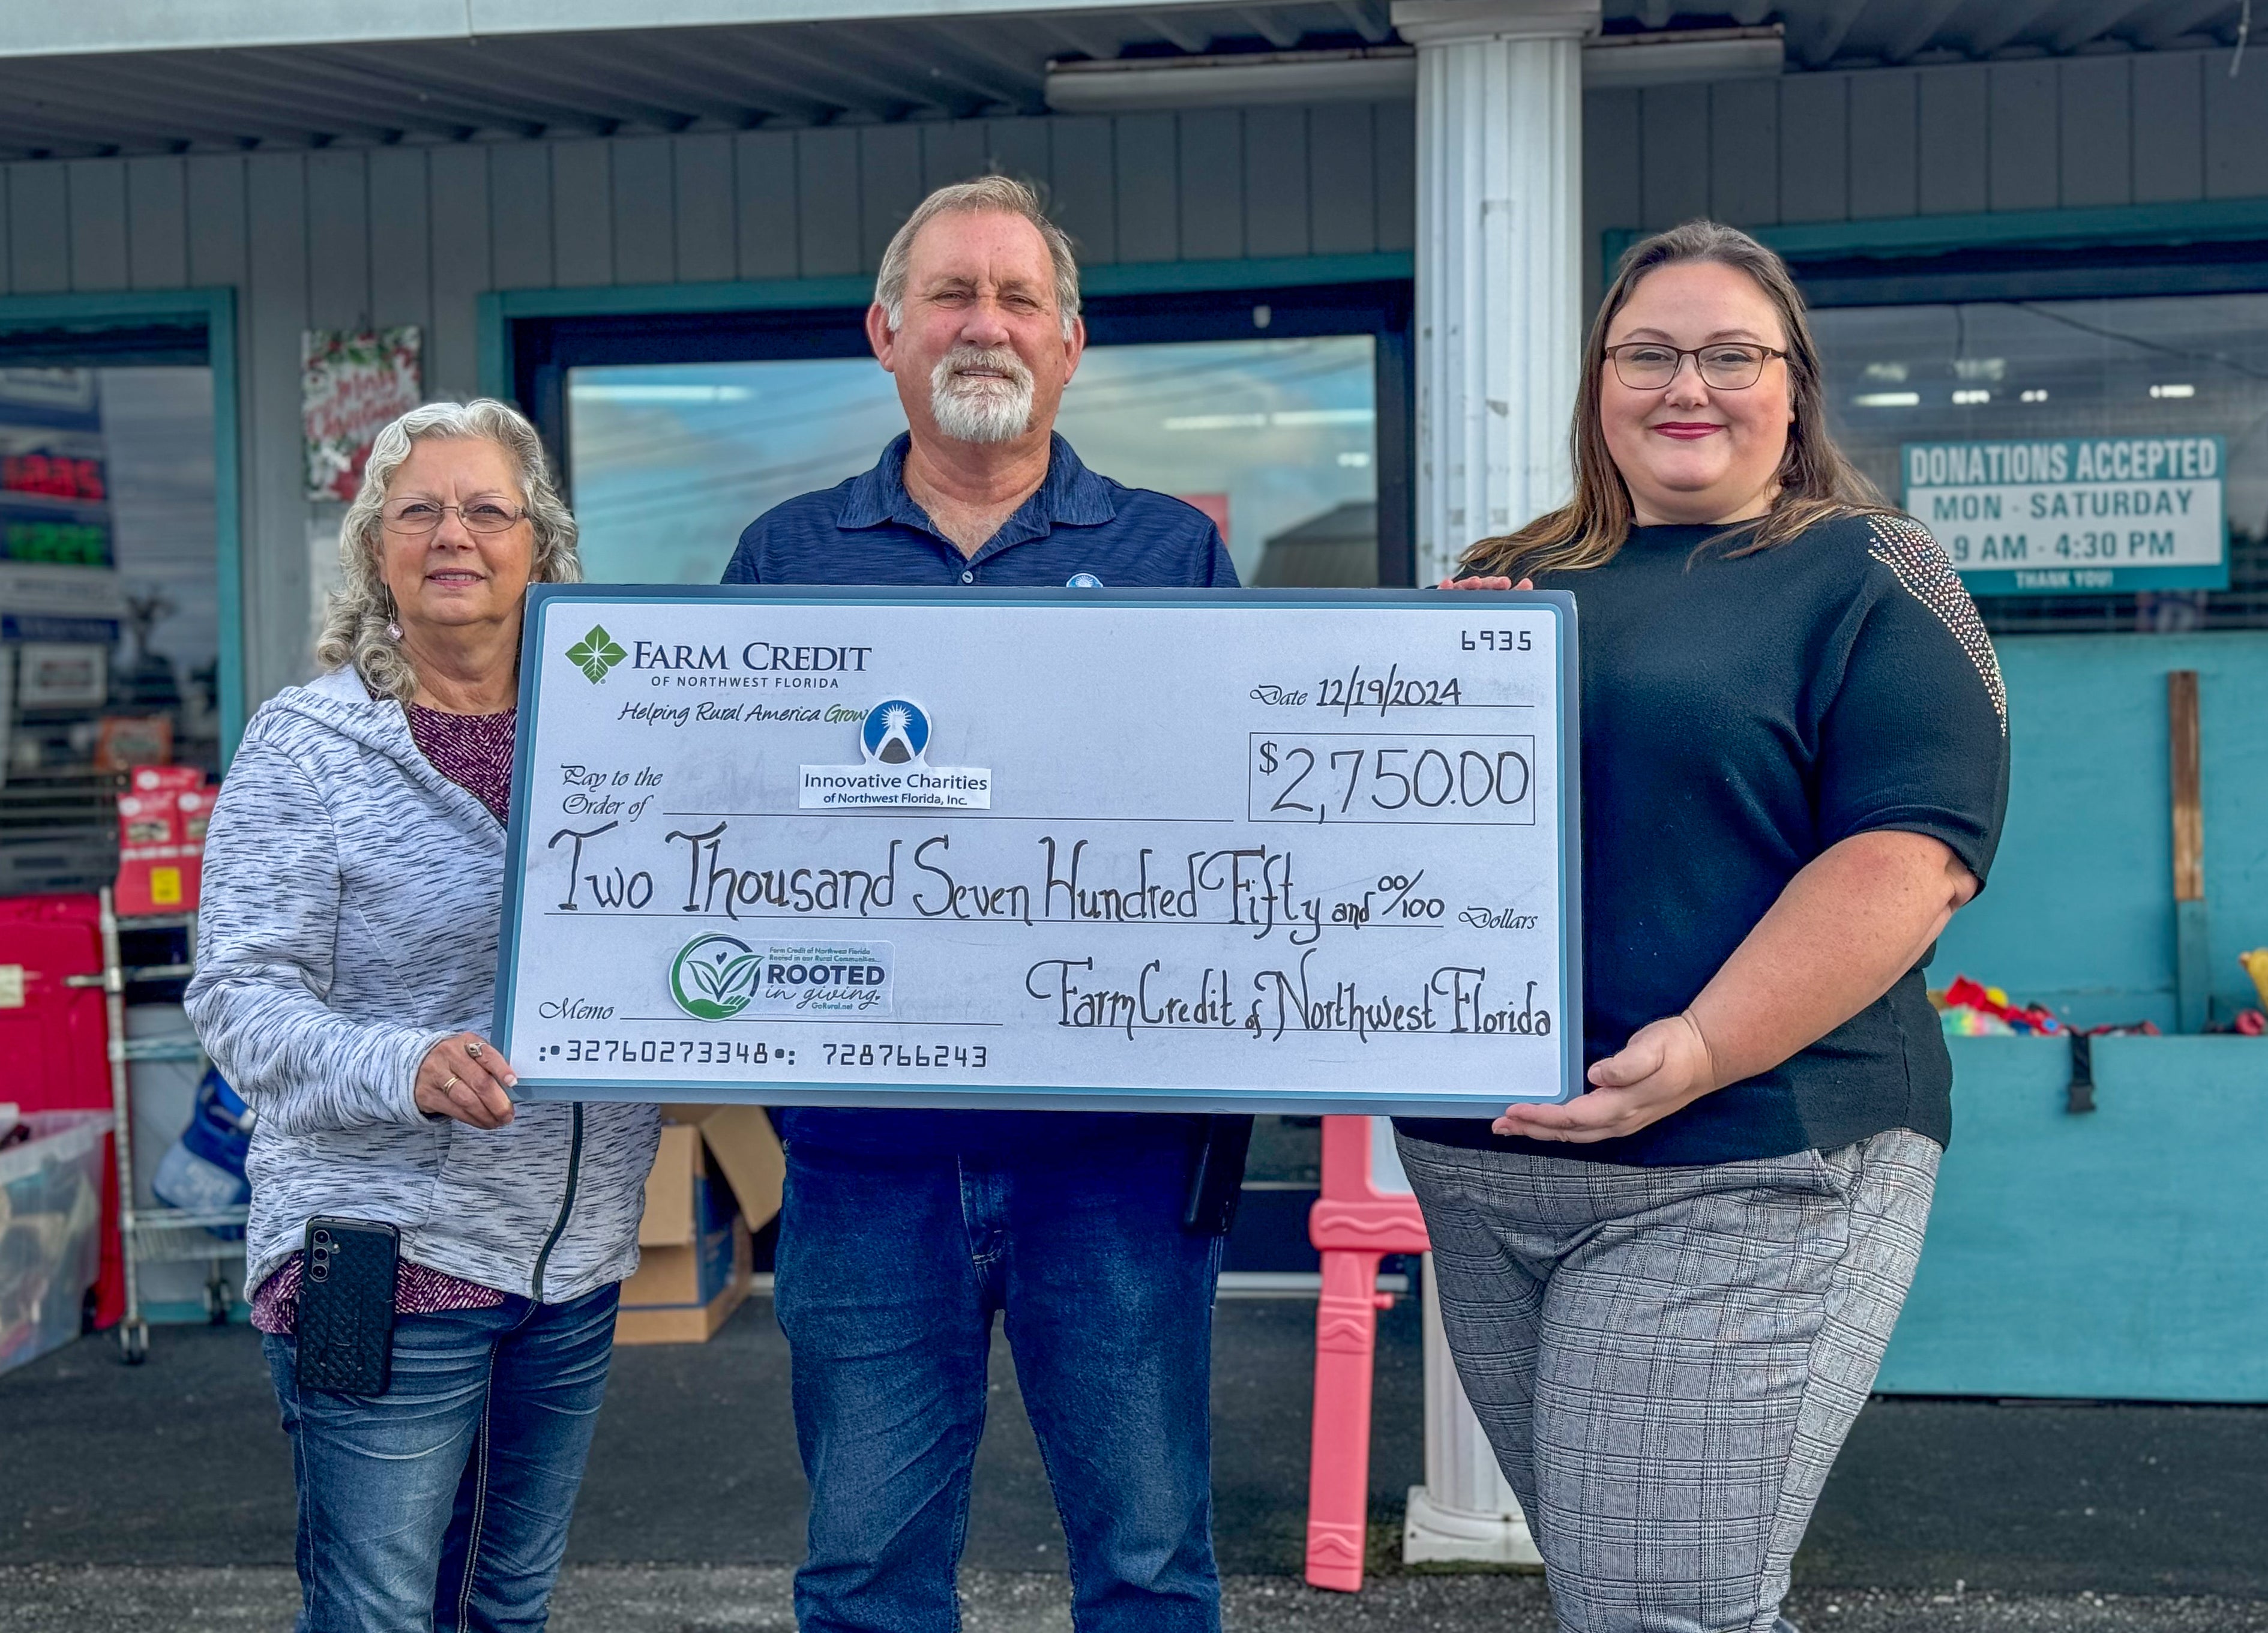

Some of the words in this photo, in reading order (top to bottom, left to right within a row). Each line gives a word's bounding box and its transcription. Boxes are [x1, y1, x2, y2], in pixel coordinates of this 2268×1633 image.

[1910, 444, 2068, 484] DONATIONS
[2077, 439, 2217, 480] ACCEPTED
[1933, 494, 2002, 521] MON
[2030, 490, 2194, 519] SATURDAY
[1954, 535, 1969, 561] 9
[1981, 535, 2027, 560] AM
[2054, 533, 2116, 559] 4:30
[2129, 532, 2175, 557] PM
[1461, 630, 1532, 651] 6935
[631, 640, 730, 670] FARM
[742, 642, 873, 672] CREDIT
[651, 676, 670, 687] OF
[677, 676, 768, 688] NORTHWEST
[775, 677, 840, 689] FLORIDA
[1249, 684, 1308, 706] Date
[1316, 663, 1462, 717] 12/19/2024
[617, 702, 691, 728] Helping
[696, 702, 743, 722] Rural
[744, 704, 820, 723] America
[561, 763, 607, 792] Pay
[611, 770, 630, 786] to
[634, 766, 664, 787] the
[804, 773, 902, 789] Innovative
[906, 773, 988, 790] Charities
[1259, 740, 1530, 824] $2,750.00
[562, 793, 625, 815] Order
[628, 794, 655, 823] of
[823, 793, 837, 804] of
[838, 793, 898, 804] Northwest
[901, 793, 944, 805] Florida,
[548, 820, 654, 912] Two
[664, 820, 903, 922] Thousand
[912, 834, 1033, 927] Seven
[1038, 835, 1206, 922] Hundred
[1198, 844, 1321, 946] Fifty
[1331, 891, 1377, 930] and
[1458, 904, 1539, 930] Dollars
[767, 964, 885, 985] ROOTED
[765, 985, 797, 1000] in
[1025, 955, 1136, 1041] Farm
[1139, 958, 1236, 1027] Credit
[1244, 999, 1263, 1040] of
[1254, 947, 1437, 1044] Northwest
[1431, 966, 1551, 1036] Florida
[539, 997, 615, 1020] Memo
[822, 1043, 987, 1068] 728766243
